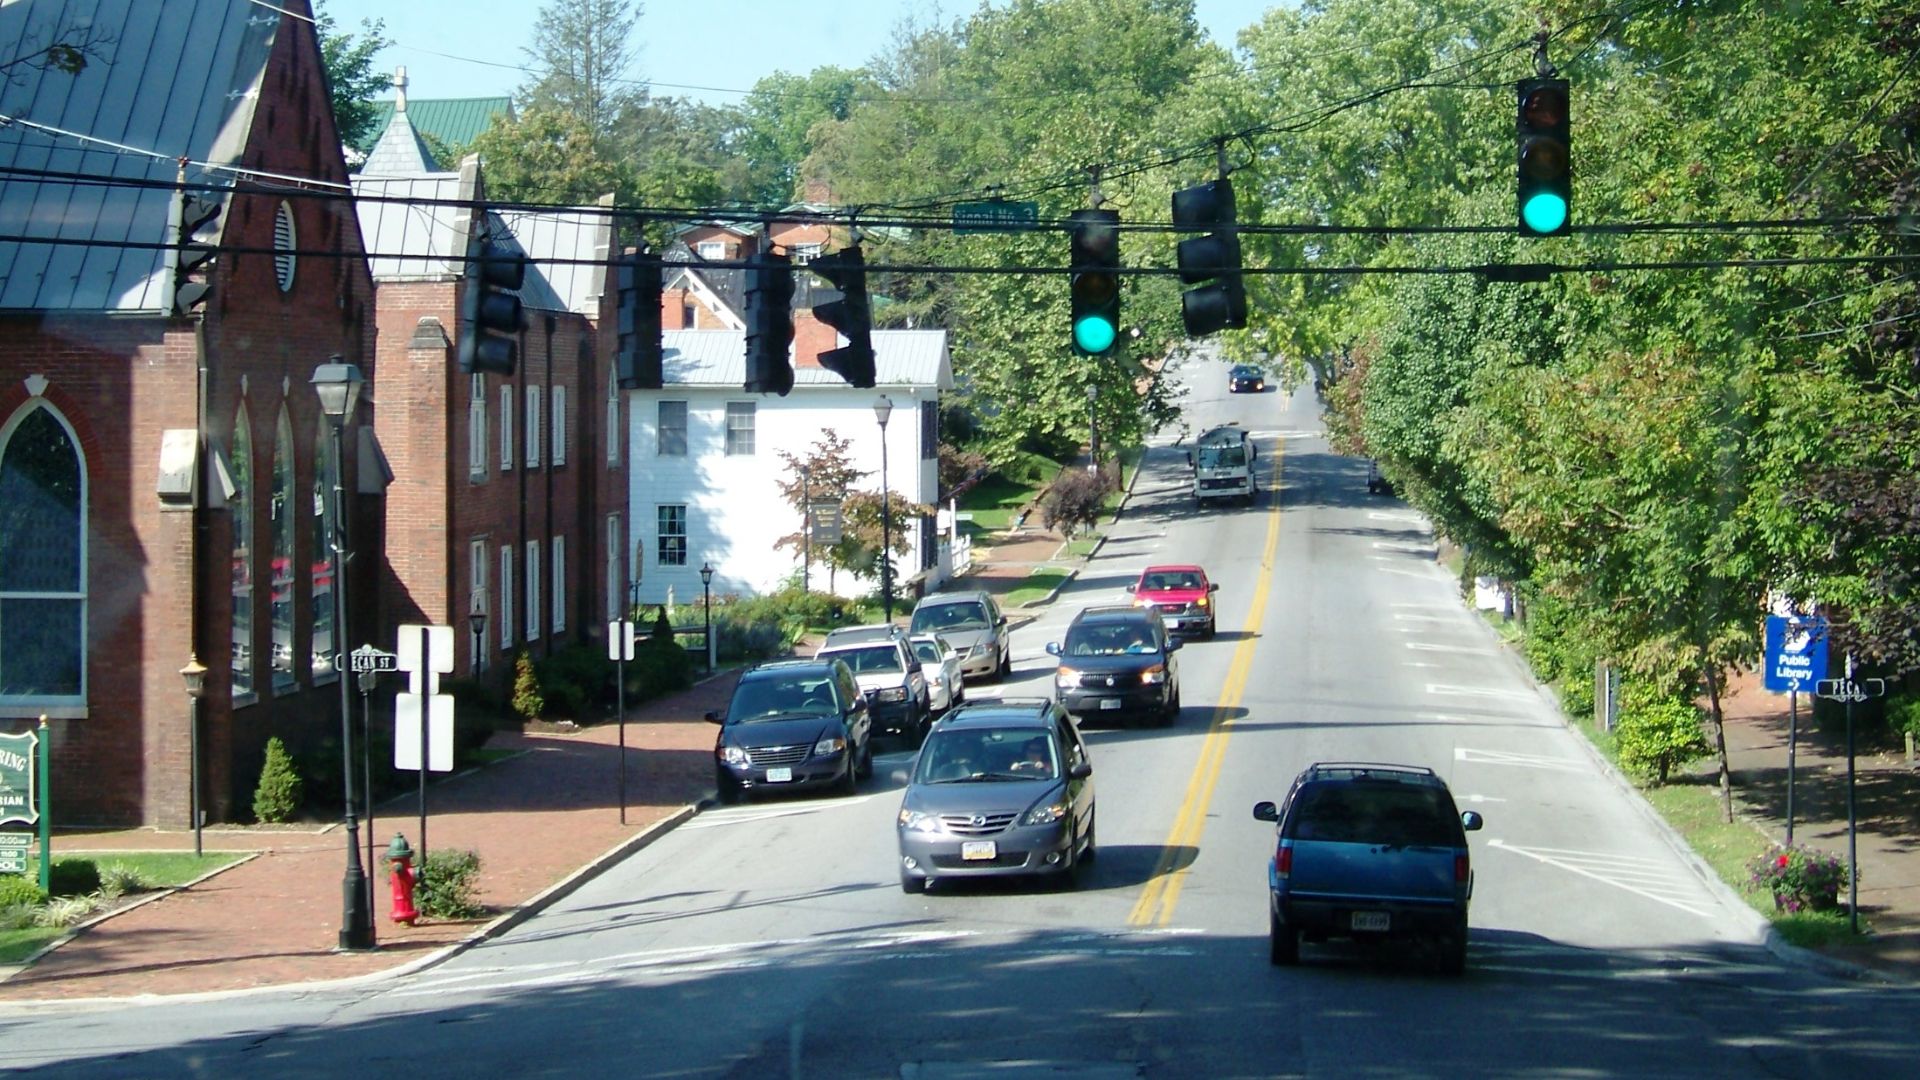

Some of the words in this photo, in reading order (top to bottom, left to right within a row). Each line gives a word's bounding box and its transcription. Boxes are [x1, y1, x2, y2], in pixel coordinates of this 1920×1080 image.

[349, 656, 376, 669] ECAN
[380, 657, 390, 668] ST
[1779, 654, 1810, 666] Public
[1776, 667, 1813, 680] Library
